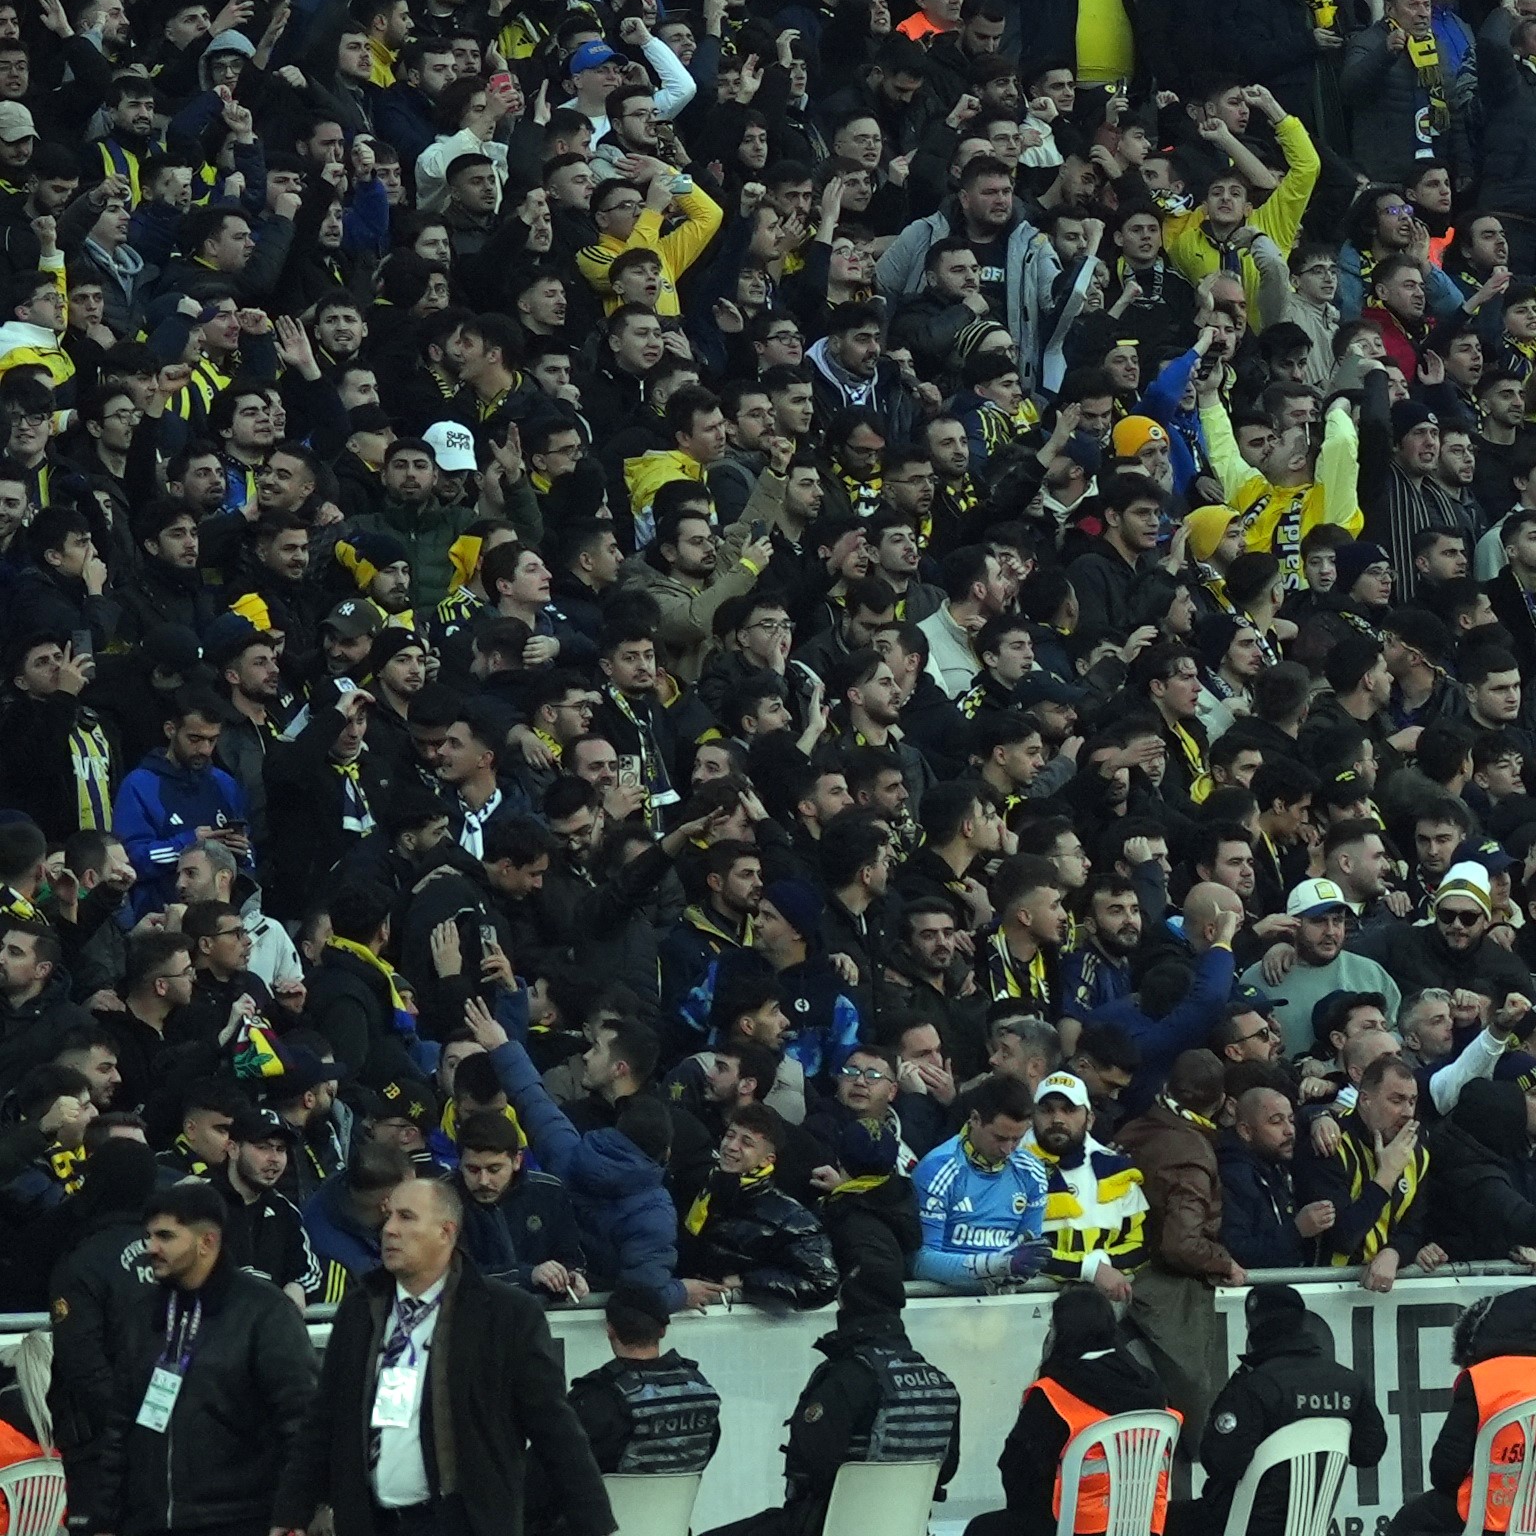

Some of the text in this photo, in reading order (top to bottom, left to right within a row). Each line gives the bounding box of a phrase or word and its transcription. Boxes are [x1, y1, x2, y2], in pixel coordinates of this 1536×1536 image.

[892, 1369, 943, 1389] POLİS
[1296, 1391, 1353, 1411] POLİS
[653, 1414, 712, 1436] POLİS
